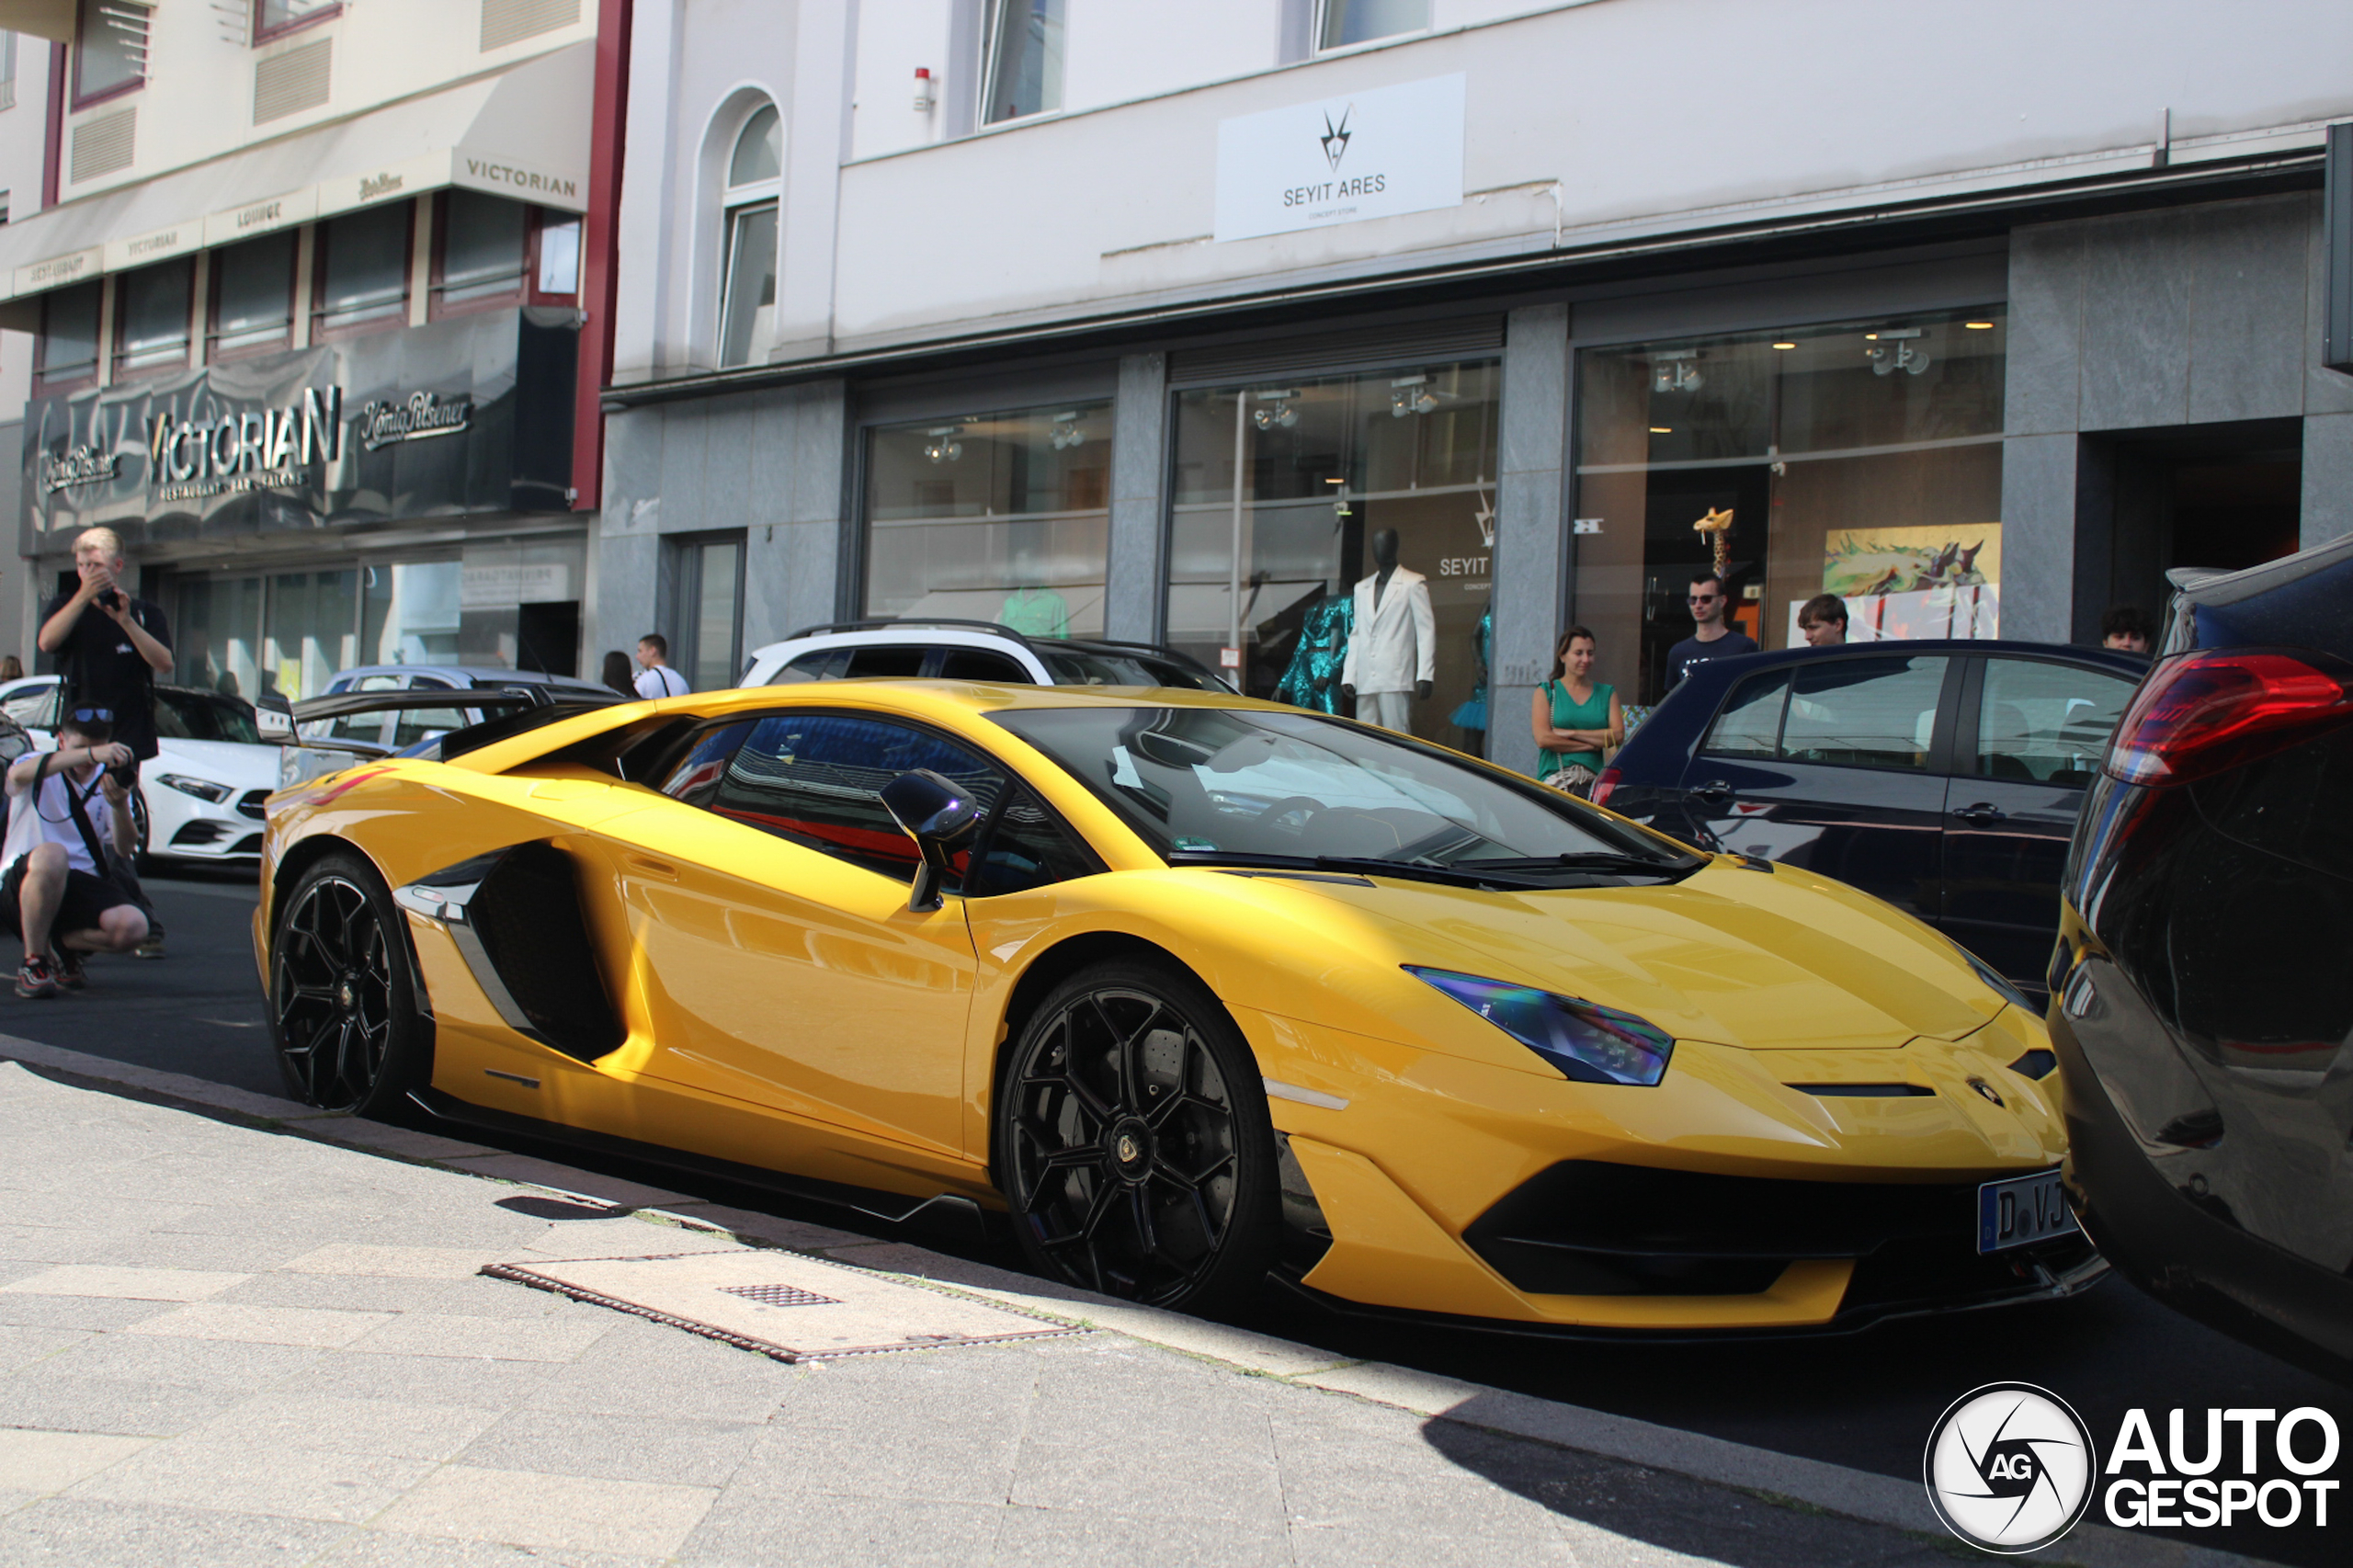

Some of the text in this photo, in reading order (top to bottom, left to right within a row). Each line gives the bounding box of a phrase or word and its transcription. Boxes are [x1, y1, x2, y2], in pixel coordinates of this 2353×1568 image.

[467, 158, 576, 197] VICTORIAN
[1284, 174, 1385, 207] SEYIT ARES
[237, 201, 281, 228] LOUNGE
[128, 232, 178, 257] VICTORIAN
[404, 391, 469, 432] Pilsener
[142, 384, 341, 484] VICTORIAN
[160, 482, 222, 502] RESTAURANT
[231, 477, 253, 494] BAR
[1439, 557, 1489, 576] SEYIT
[1997, 1190, 2016, 1241] D
